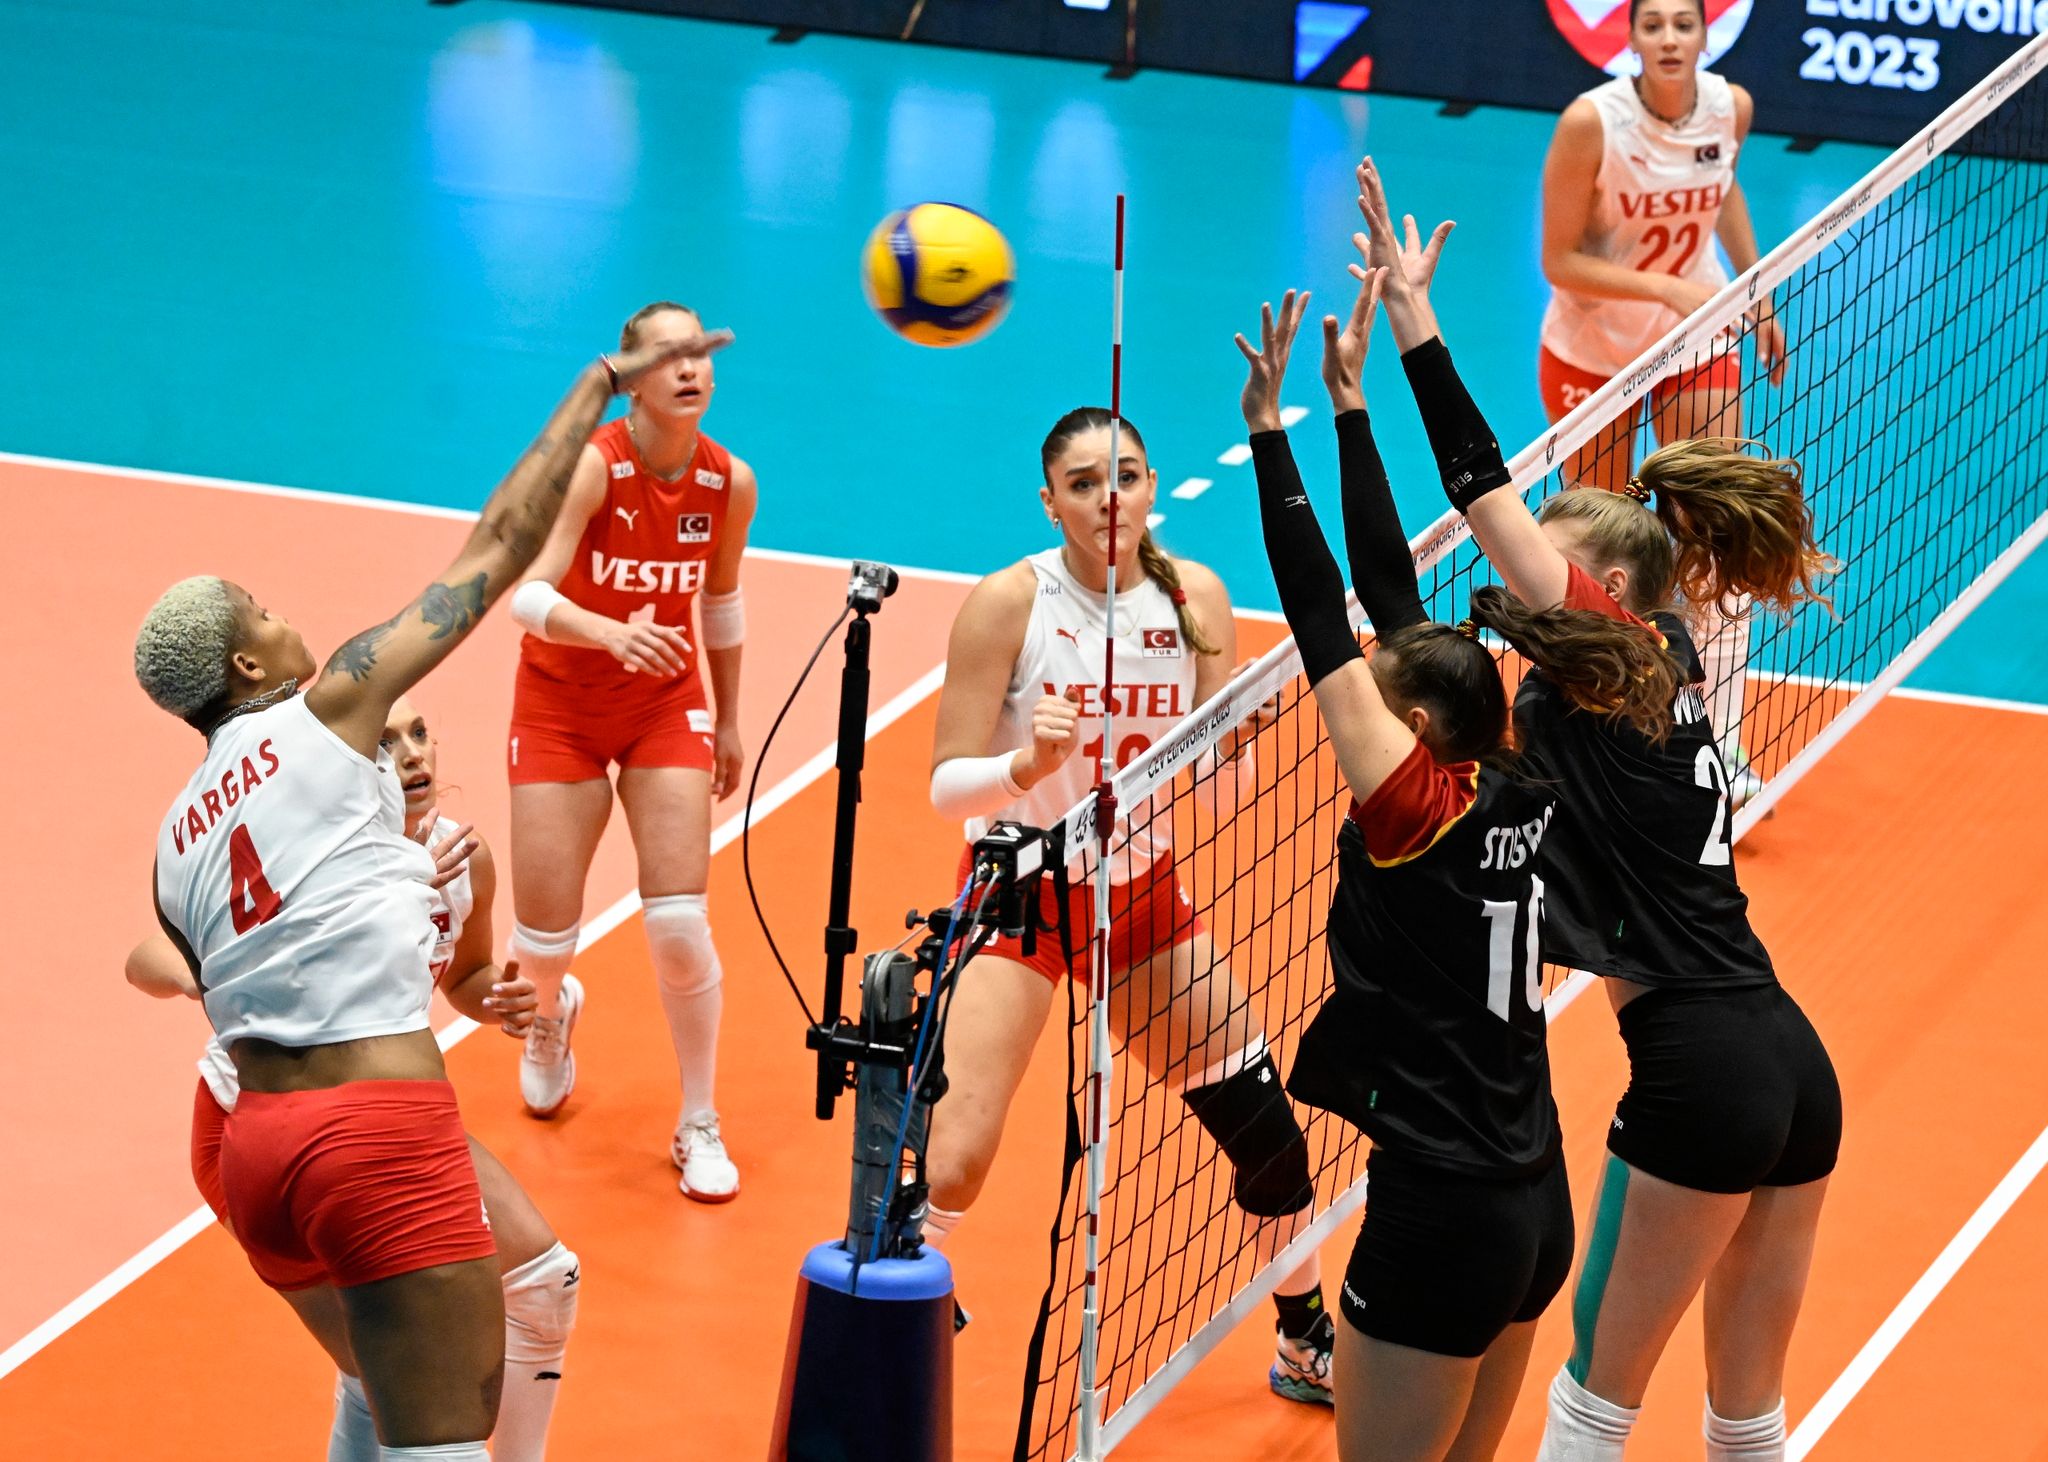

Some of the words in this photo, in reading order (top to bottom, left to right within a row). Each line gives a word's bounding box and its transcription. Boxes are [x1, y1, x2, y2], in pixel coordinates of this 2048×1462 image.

[1800, 27, 1941, 91] 2023
[1635, 222, 1699, 277] 22
[511, 736, 519, 766] 1
[172, 738, 279, 856] VARGAS
[229, 822, 283, 936] 4
